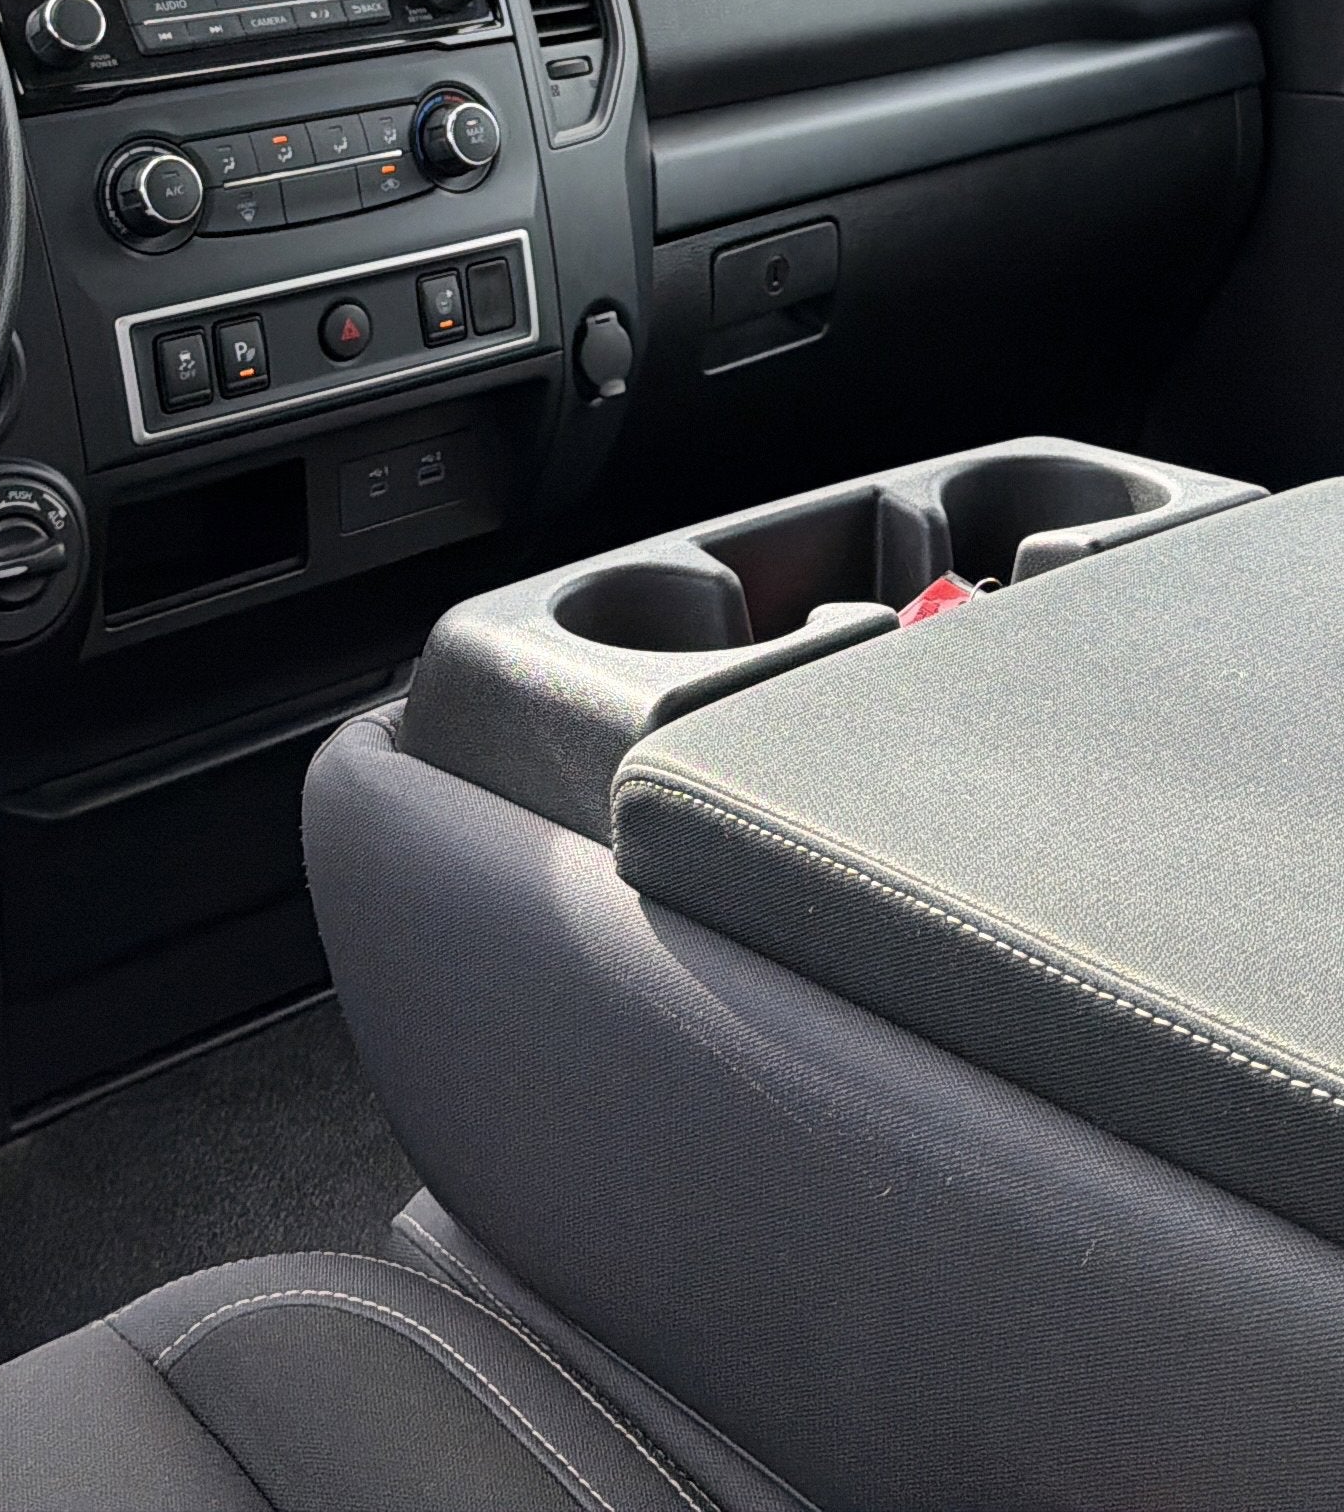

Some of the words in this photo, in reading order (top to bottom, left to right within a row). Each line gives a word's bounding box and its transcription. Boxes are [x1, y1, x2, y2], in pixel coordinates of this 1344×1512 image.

[155, 0, 187, 13] AUDIO
[361, 3, 384, 13] BACK
[251, 15, 287, 28] CAMERA
[165, 185, 185, 198] A/C
[179, 369, 196, 381] OFF
[8, 490, 33, 501] PUSH
